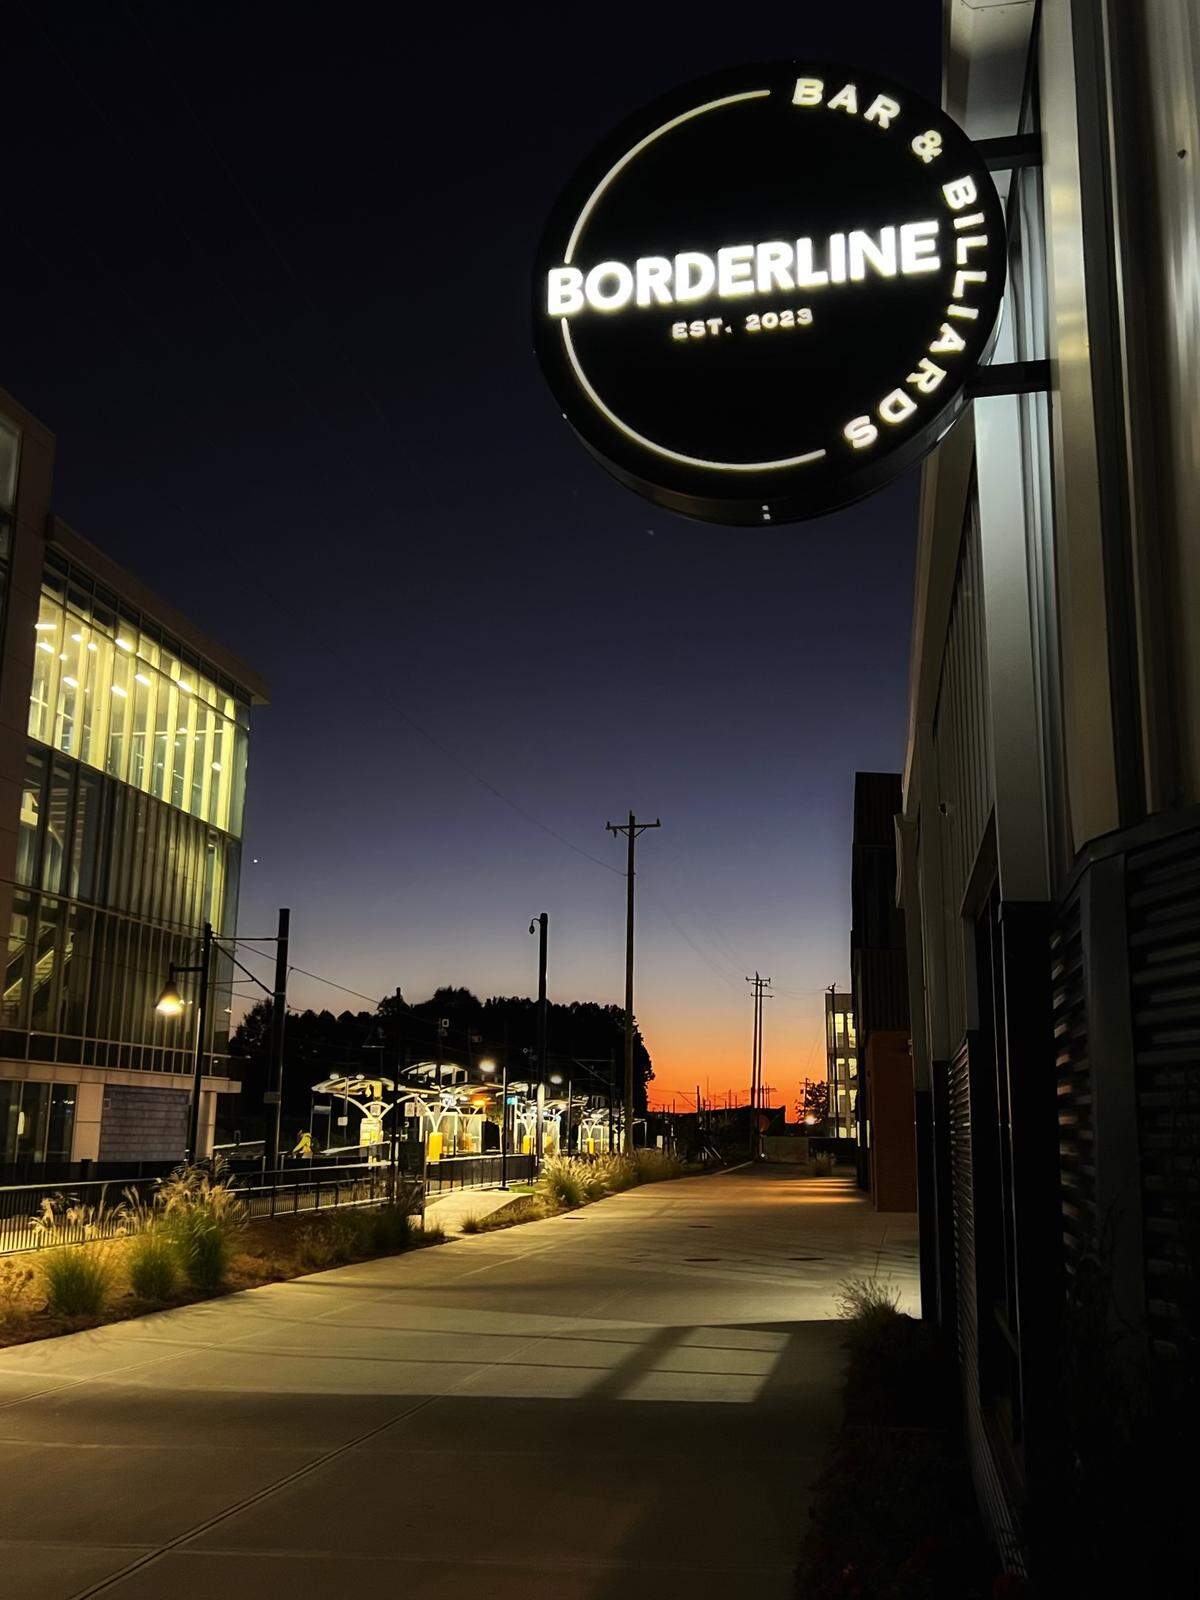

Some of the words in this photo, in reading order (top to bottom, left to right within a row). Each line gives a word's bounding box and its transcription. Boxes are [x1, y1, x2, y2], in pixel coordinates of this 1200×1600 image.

[791, 77, 901, 129] BAR
[911, 129, 943, 164] &
[547, 219, 942, 317] BORDERLINE
[671, 317, 732, 340] EST.
[745, 307, 813, 332] 2023
[843, 174, 989, 449] BILLIARDS
